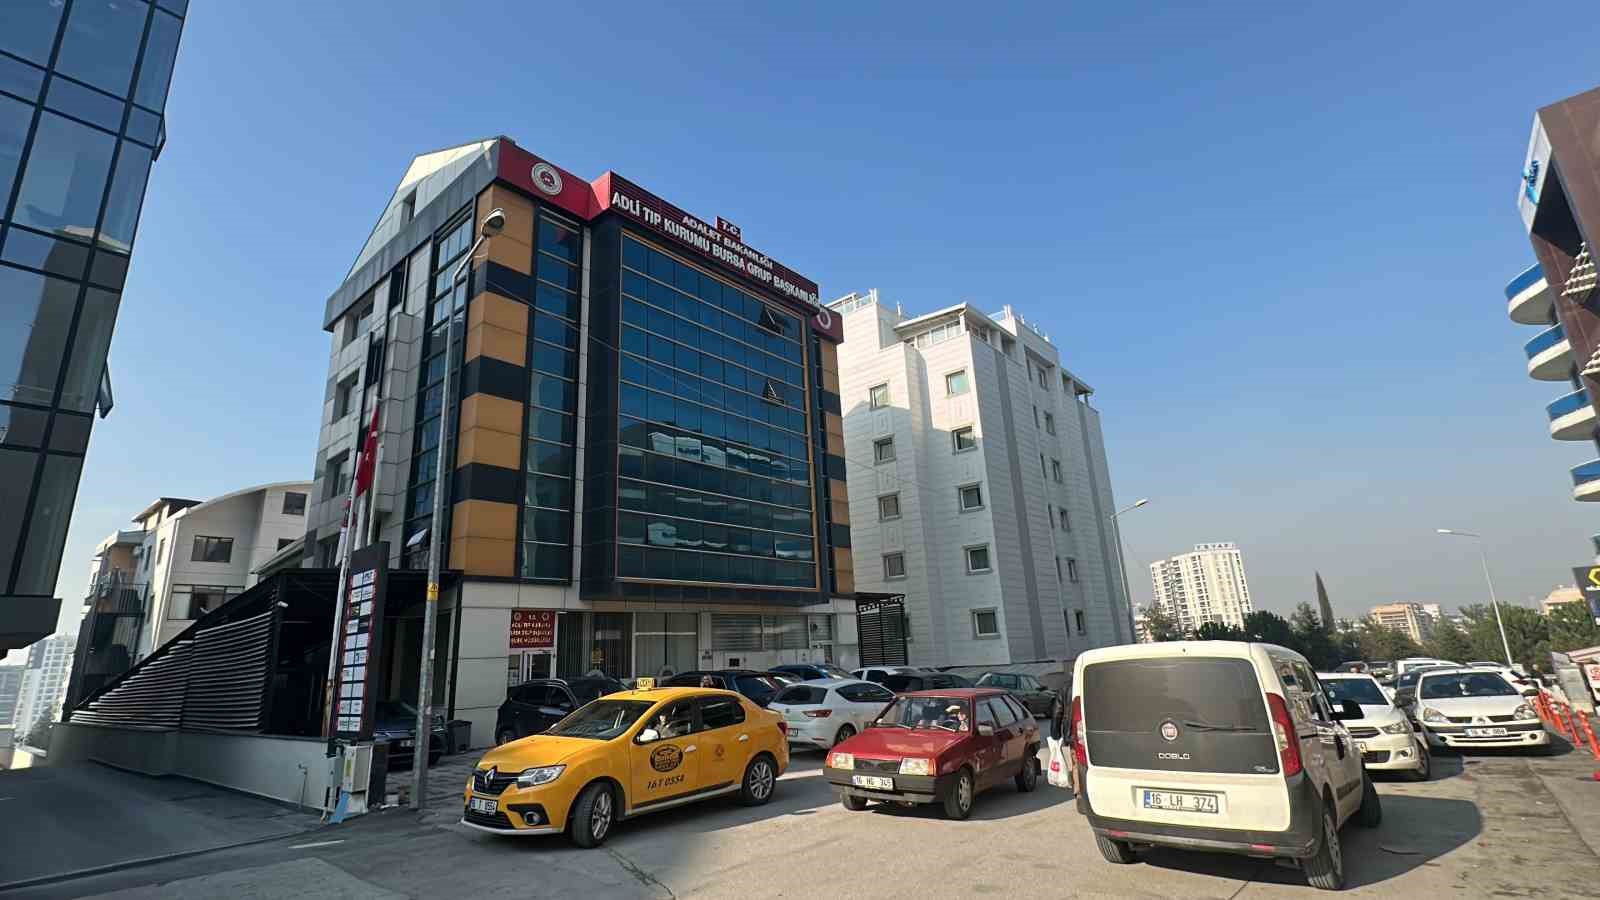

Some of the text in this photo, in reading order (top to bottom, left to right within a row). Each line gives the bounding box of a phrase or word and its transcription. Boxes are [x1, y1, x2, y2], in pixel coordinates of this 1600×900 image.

[611, 191, 640, 217] ADLİ
[642, 206, 661, 225] TIP
[664, 218, 710, 252] KURUMU
[712, 243, 746, 271] BURSA
[747, 262, 772, 283] GRUP
[682, 215, 722, 242] ADALET
[721, 220, 740, 238] T.C.
[1151, 792, 1214, 809] 16 LH 374
